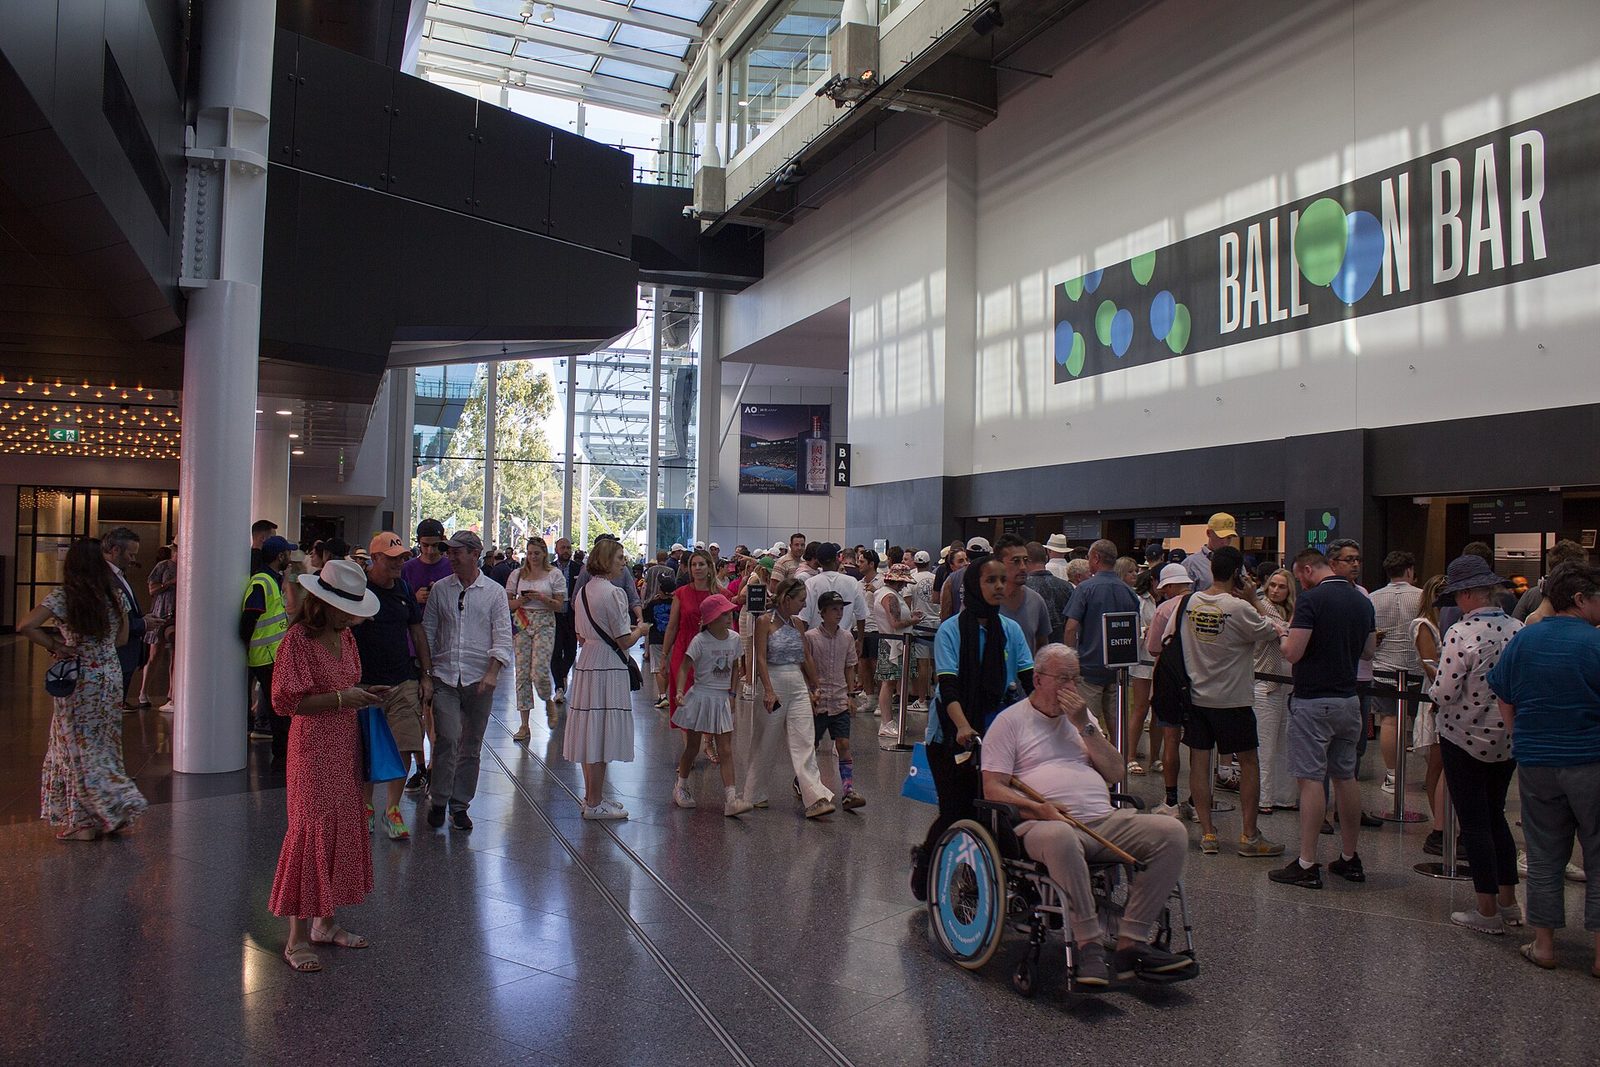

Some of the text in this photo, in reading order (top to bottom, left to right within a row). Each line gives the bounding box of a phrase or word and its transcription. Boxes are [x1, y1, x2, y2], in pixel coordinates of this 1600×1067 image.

[1431, 129, 1548, 285] BAR
[838, 448, 847, 482] BAR
[390, 539, 402, 547] AO
[1308, 530, 1328, 544] UP, UP
[1110, 638, 1132, 646] ENTRY
